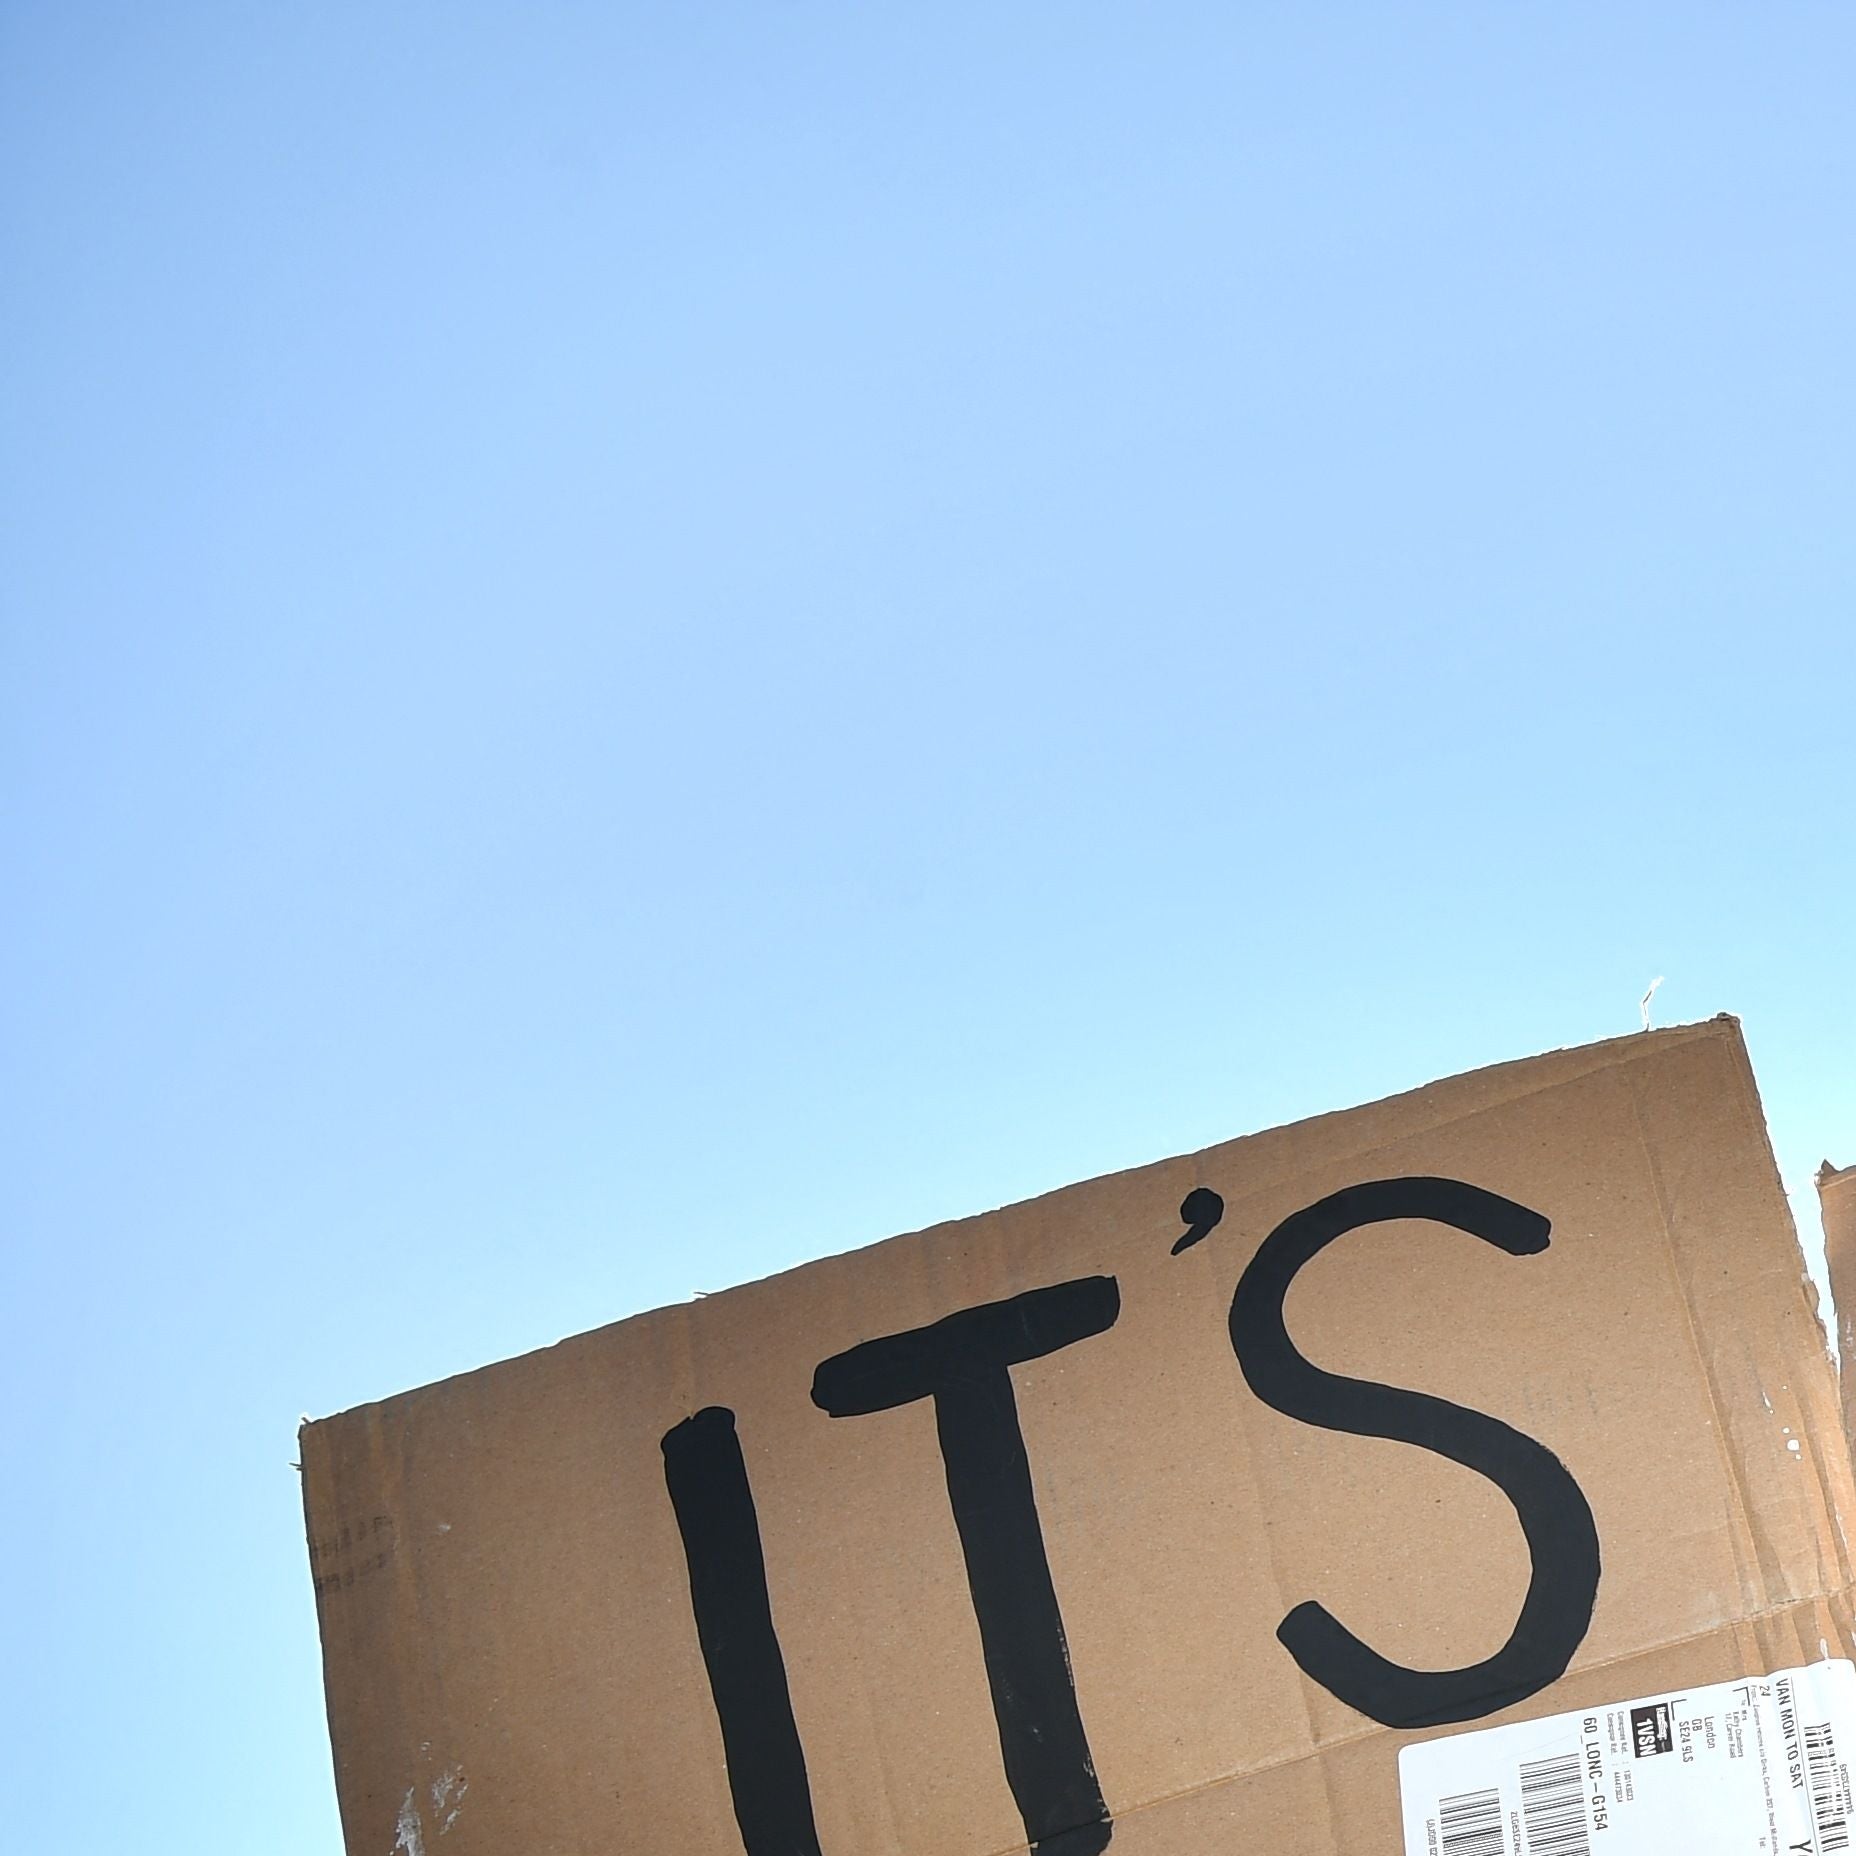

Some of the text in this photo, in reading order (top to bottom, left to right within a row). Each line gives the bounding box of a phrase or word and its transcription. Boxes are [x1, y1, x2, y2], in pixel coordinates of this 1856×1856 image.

[1759, 1685, 1771, 1697] 24
[1635, 1717, 1658, 1757] 1VSN
[1679, 1720, 1694, 1763] SE24 9LS
[1704, 1716, 1716, 1749] London
[1775, 1677, 1803, 1789] VAN MON TO SAT
